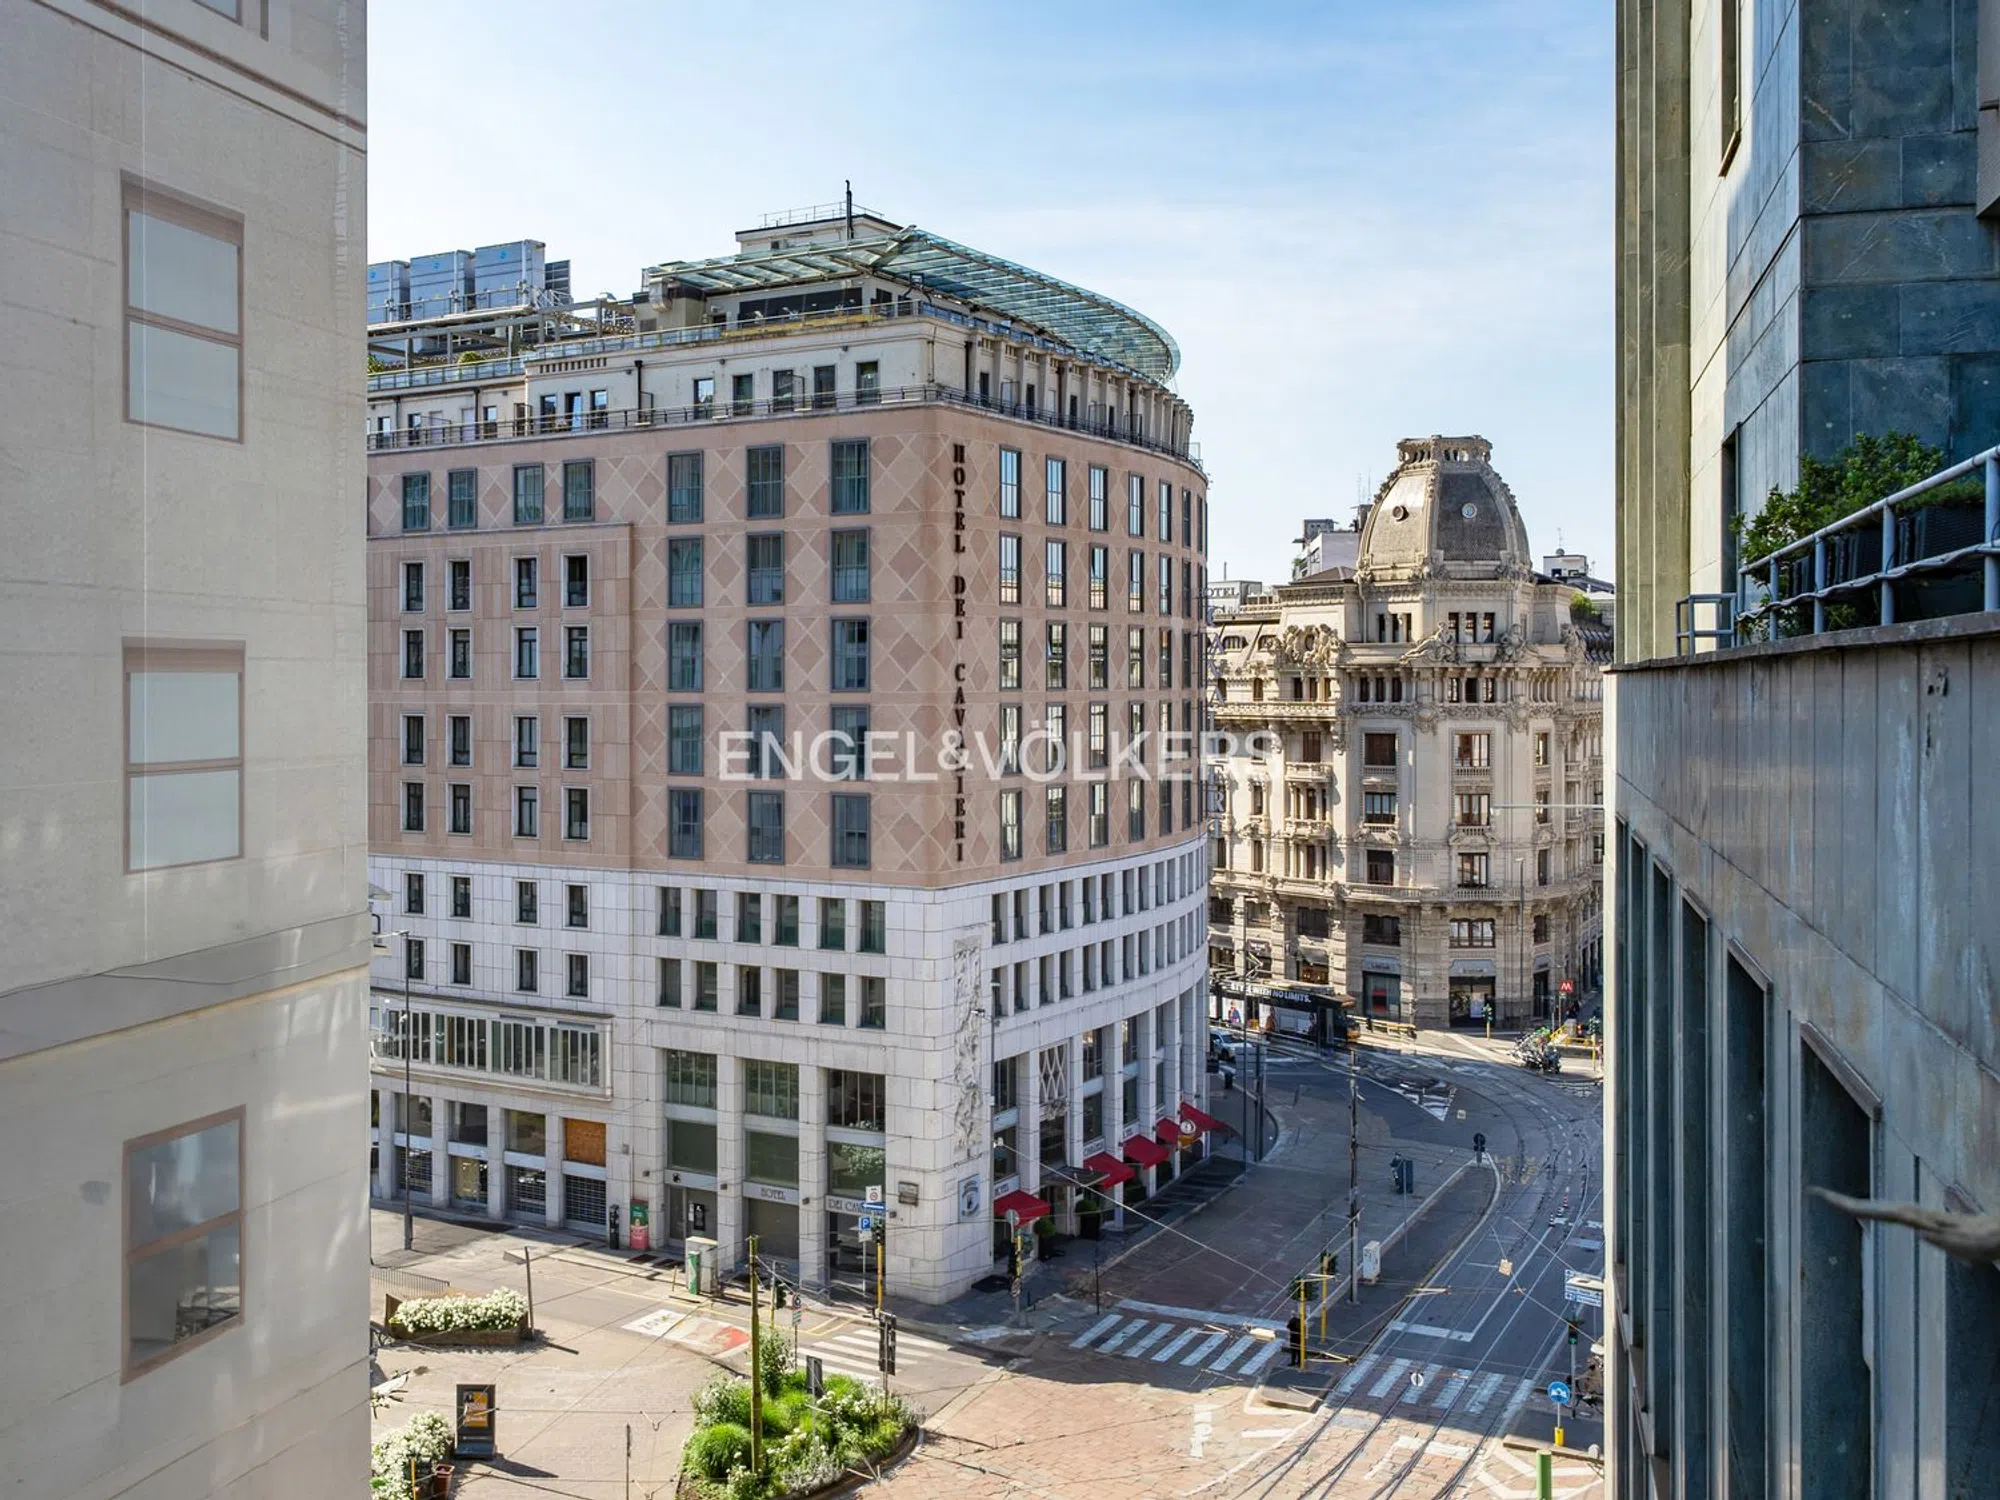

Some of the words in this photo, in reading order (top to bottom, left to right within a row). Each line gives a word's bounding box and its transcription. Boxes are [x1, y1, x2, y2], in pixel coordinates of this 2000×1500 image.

[953, 444, 966, 554] HOTEL
[954, 575, 966, 640] DEI
[1207, 587, 1240, 596] OTEL
[1273, 989, 1283, 998] NO
